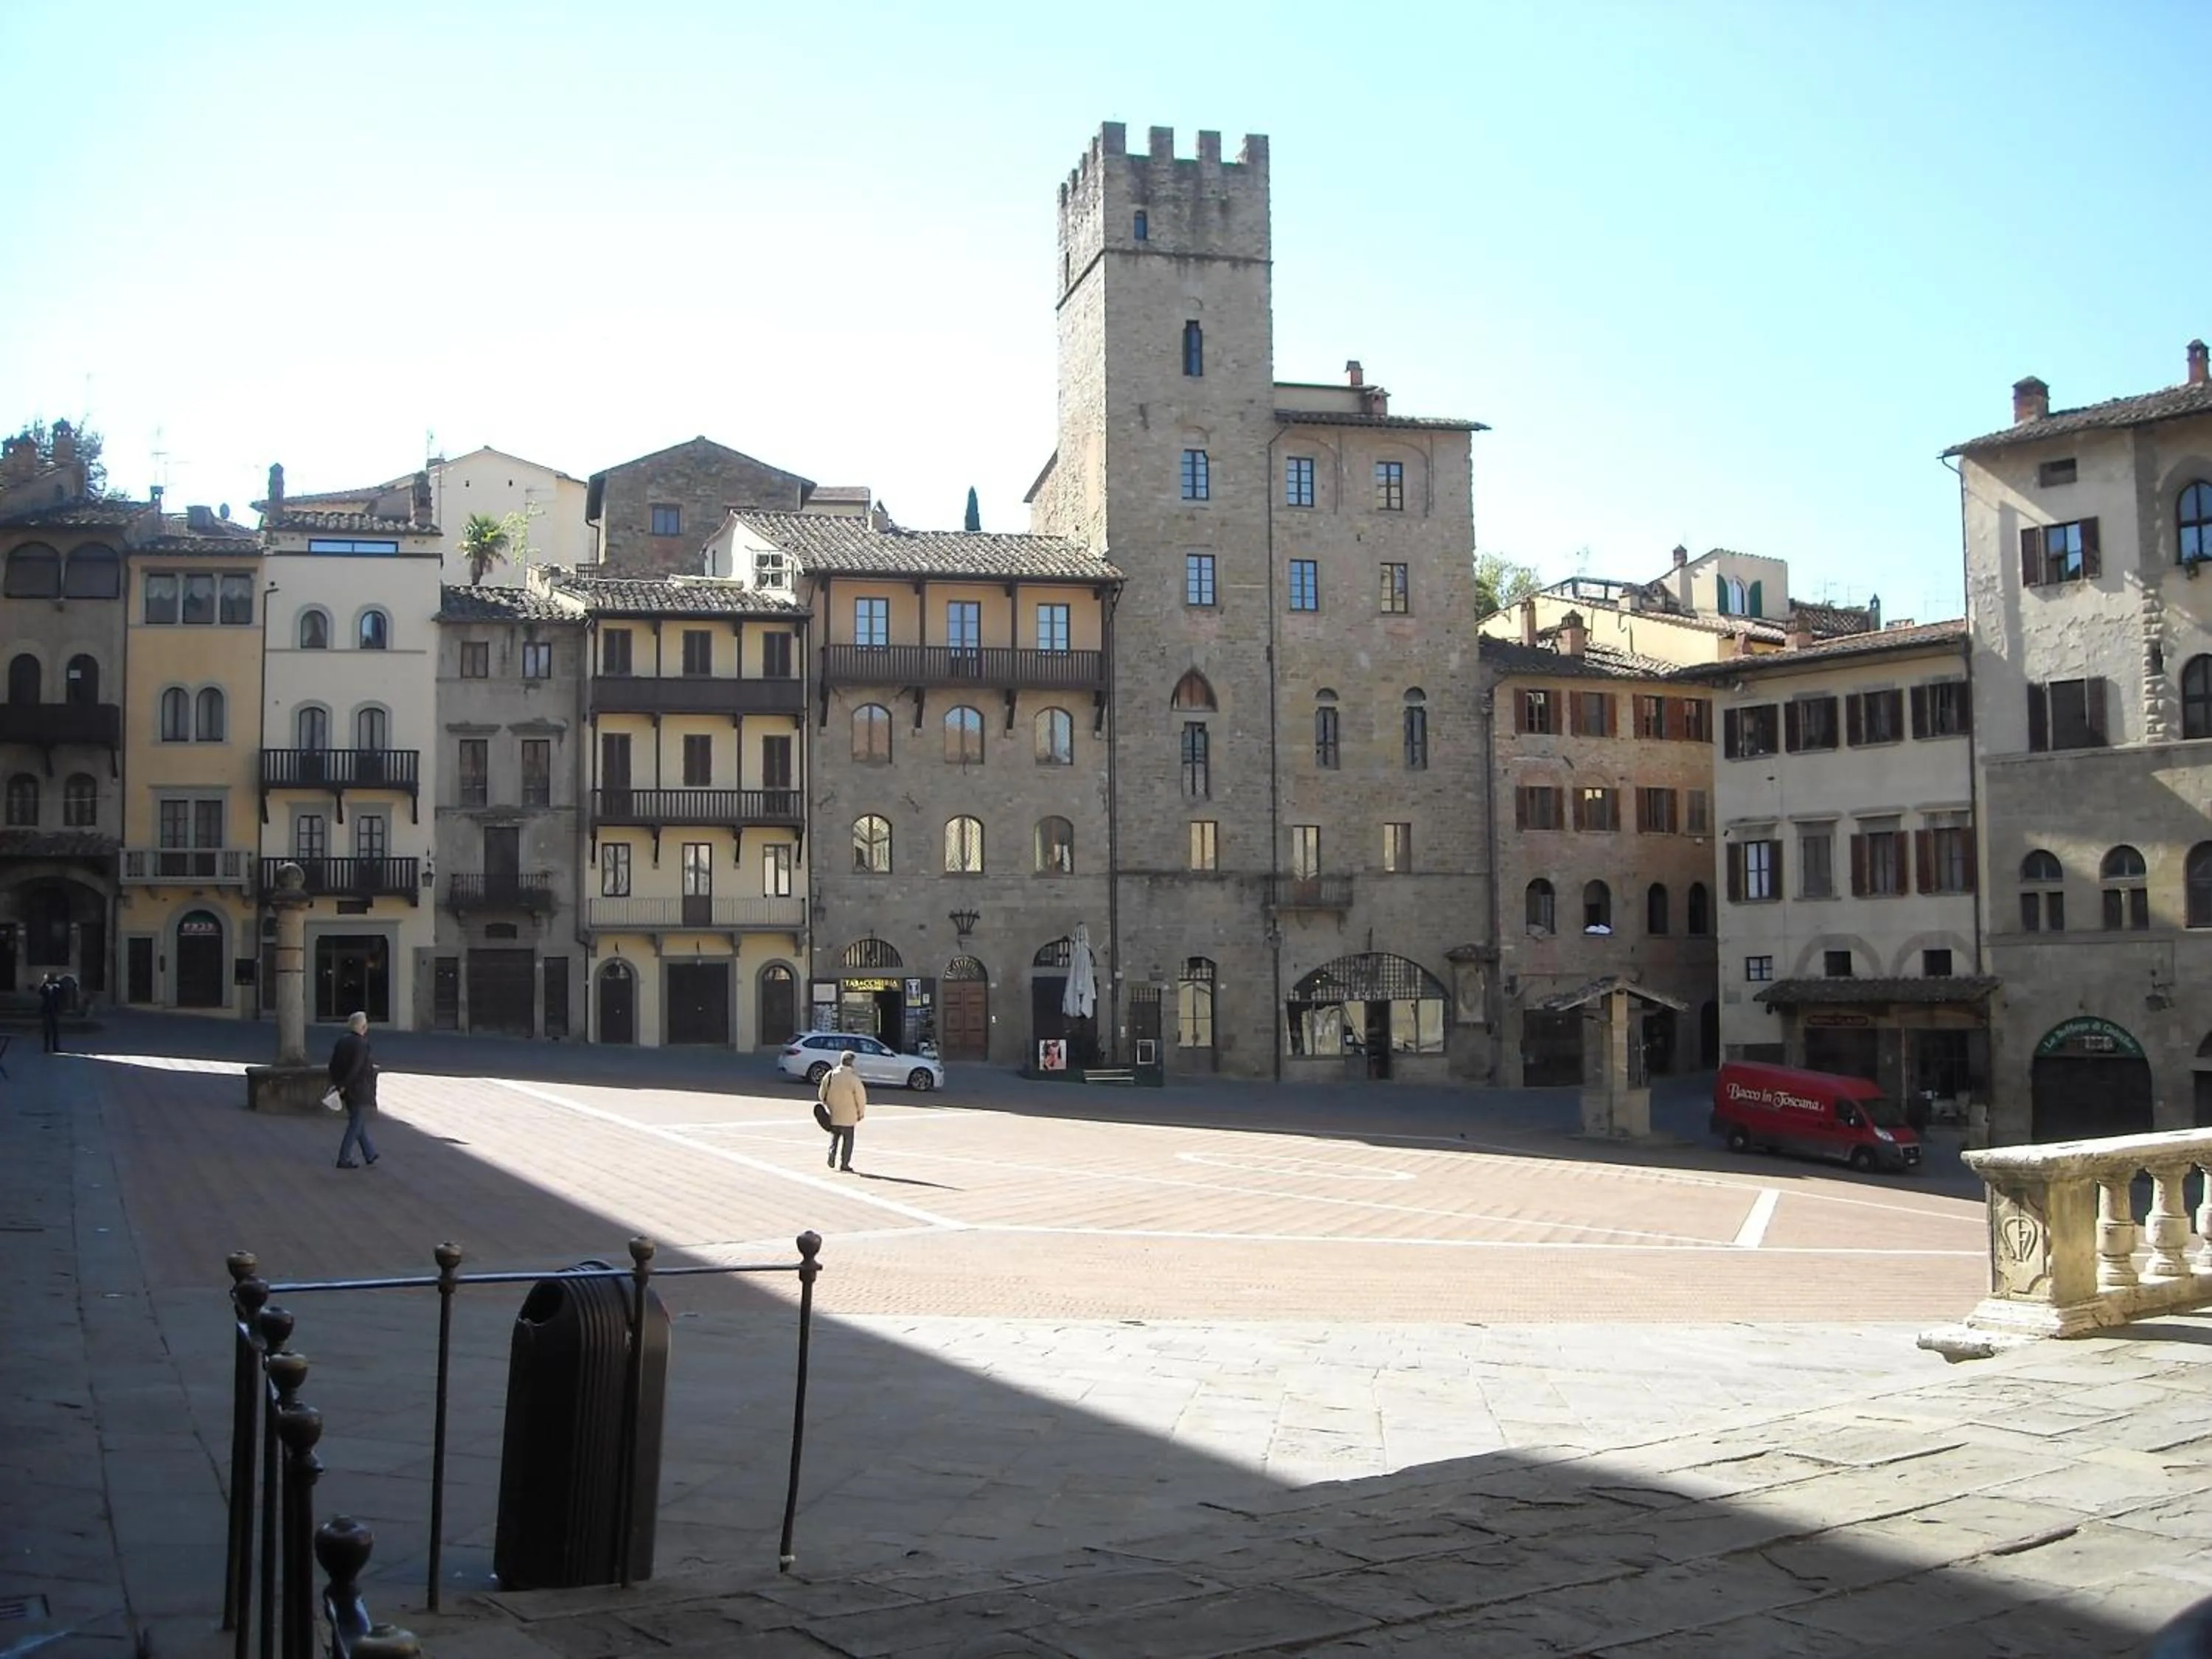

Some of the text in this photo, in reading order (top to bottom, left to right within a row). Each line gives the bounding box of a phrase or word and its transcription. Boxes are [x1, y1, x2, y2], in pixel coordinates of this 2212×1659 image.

[1726, 1082, 1759, 1101] Bacco
[1761, 1088, 1772, 1104] in
[1773, 1091, 1820, 1110] Toscana
